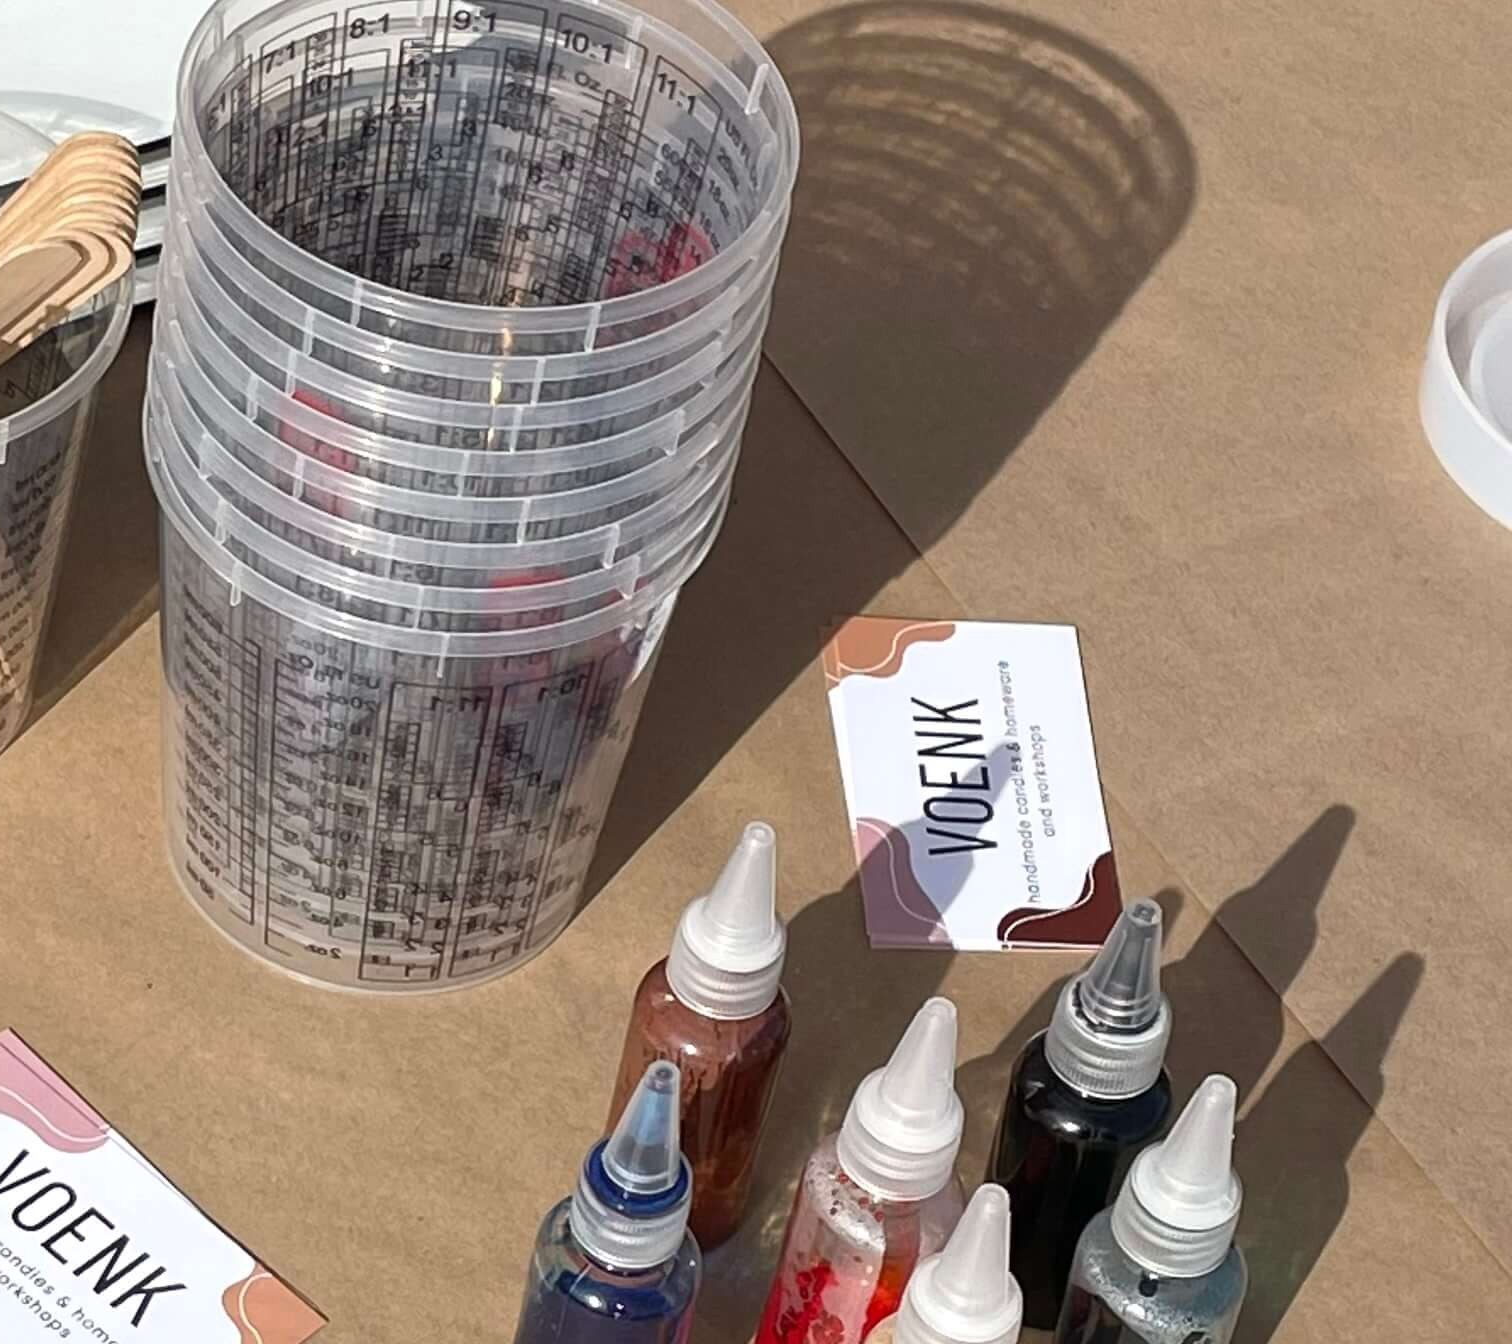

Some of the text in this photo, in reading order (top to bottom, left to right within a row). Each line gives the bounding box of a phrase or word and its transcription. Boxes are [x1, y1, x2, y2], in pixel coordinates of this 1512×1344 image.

[349, 13, 390, 39] 8:1
[453, 10, 496, 33] 9:1
[560, 28, 614, 64] 10:1
[656, 72, 697, 116] 11:1
[910, 697, 998, 855] VOENK
[996, 660, 1040, 903] handmade candles & homeware
[1029, 724, 1056, 837] and workshops
[56, 1295, 71, 1310] &
